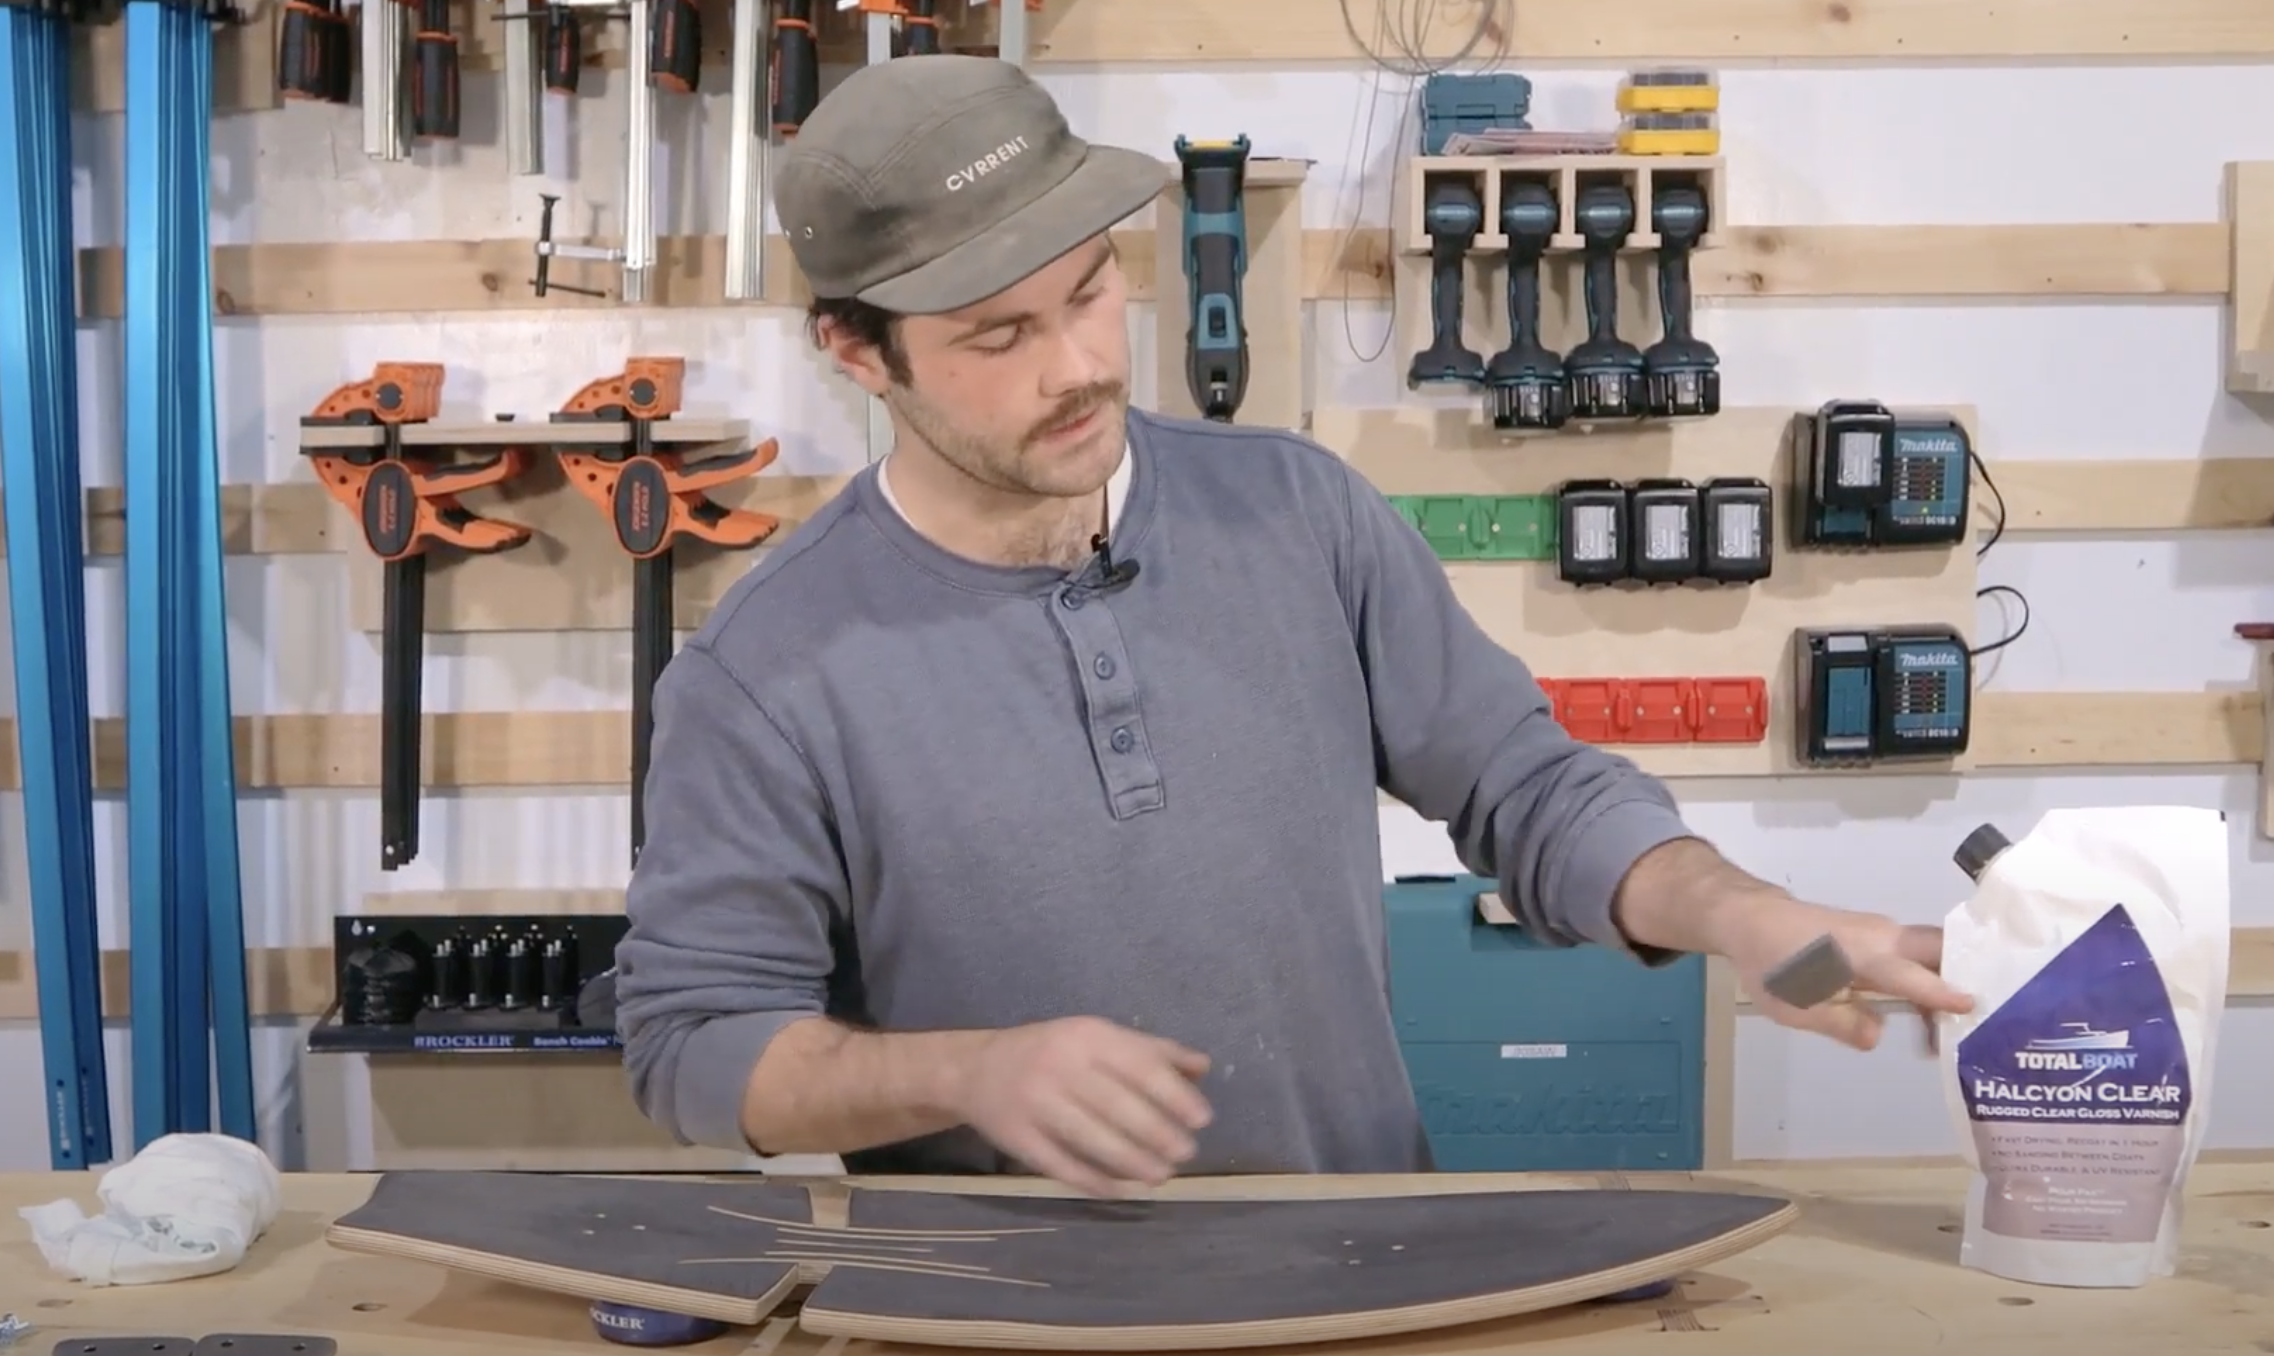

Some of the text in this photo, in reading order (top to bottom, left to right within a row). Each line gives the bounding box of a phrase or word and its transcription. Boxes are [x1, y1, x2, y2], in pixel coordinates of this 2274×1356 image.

[946, 135, 1029, 192] CVRRENT
[414, 1035, 513, 1047] BROCKLER
[2015, 1052, 2138, 1070] TOTALBOAT
[1975, 1080, 2181, 1103] HALCYON CLEAR
[1976, 1104, 2179, 1120] RUGGED CLEAR GLOSS VARNISH
